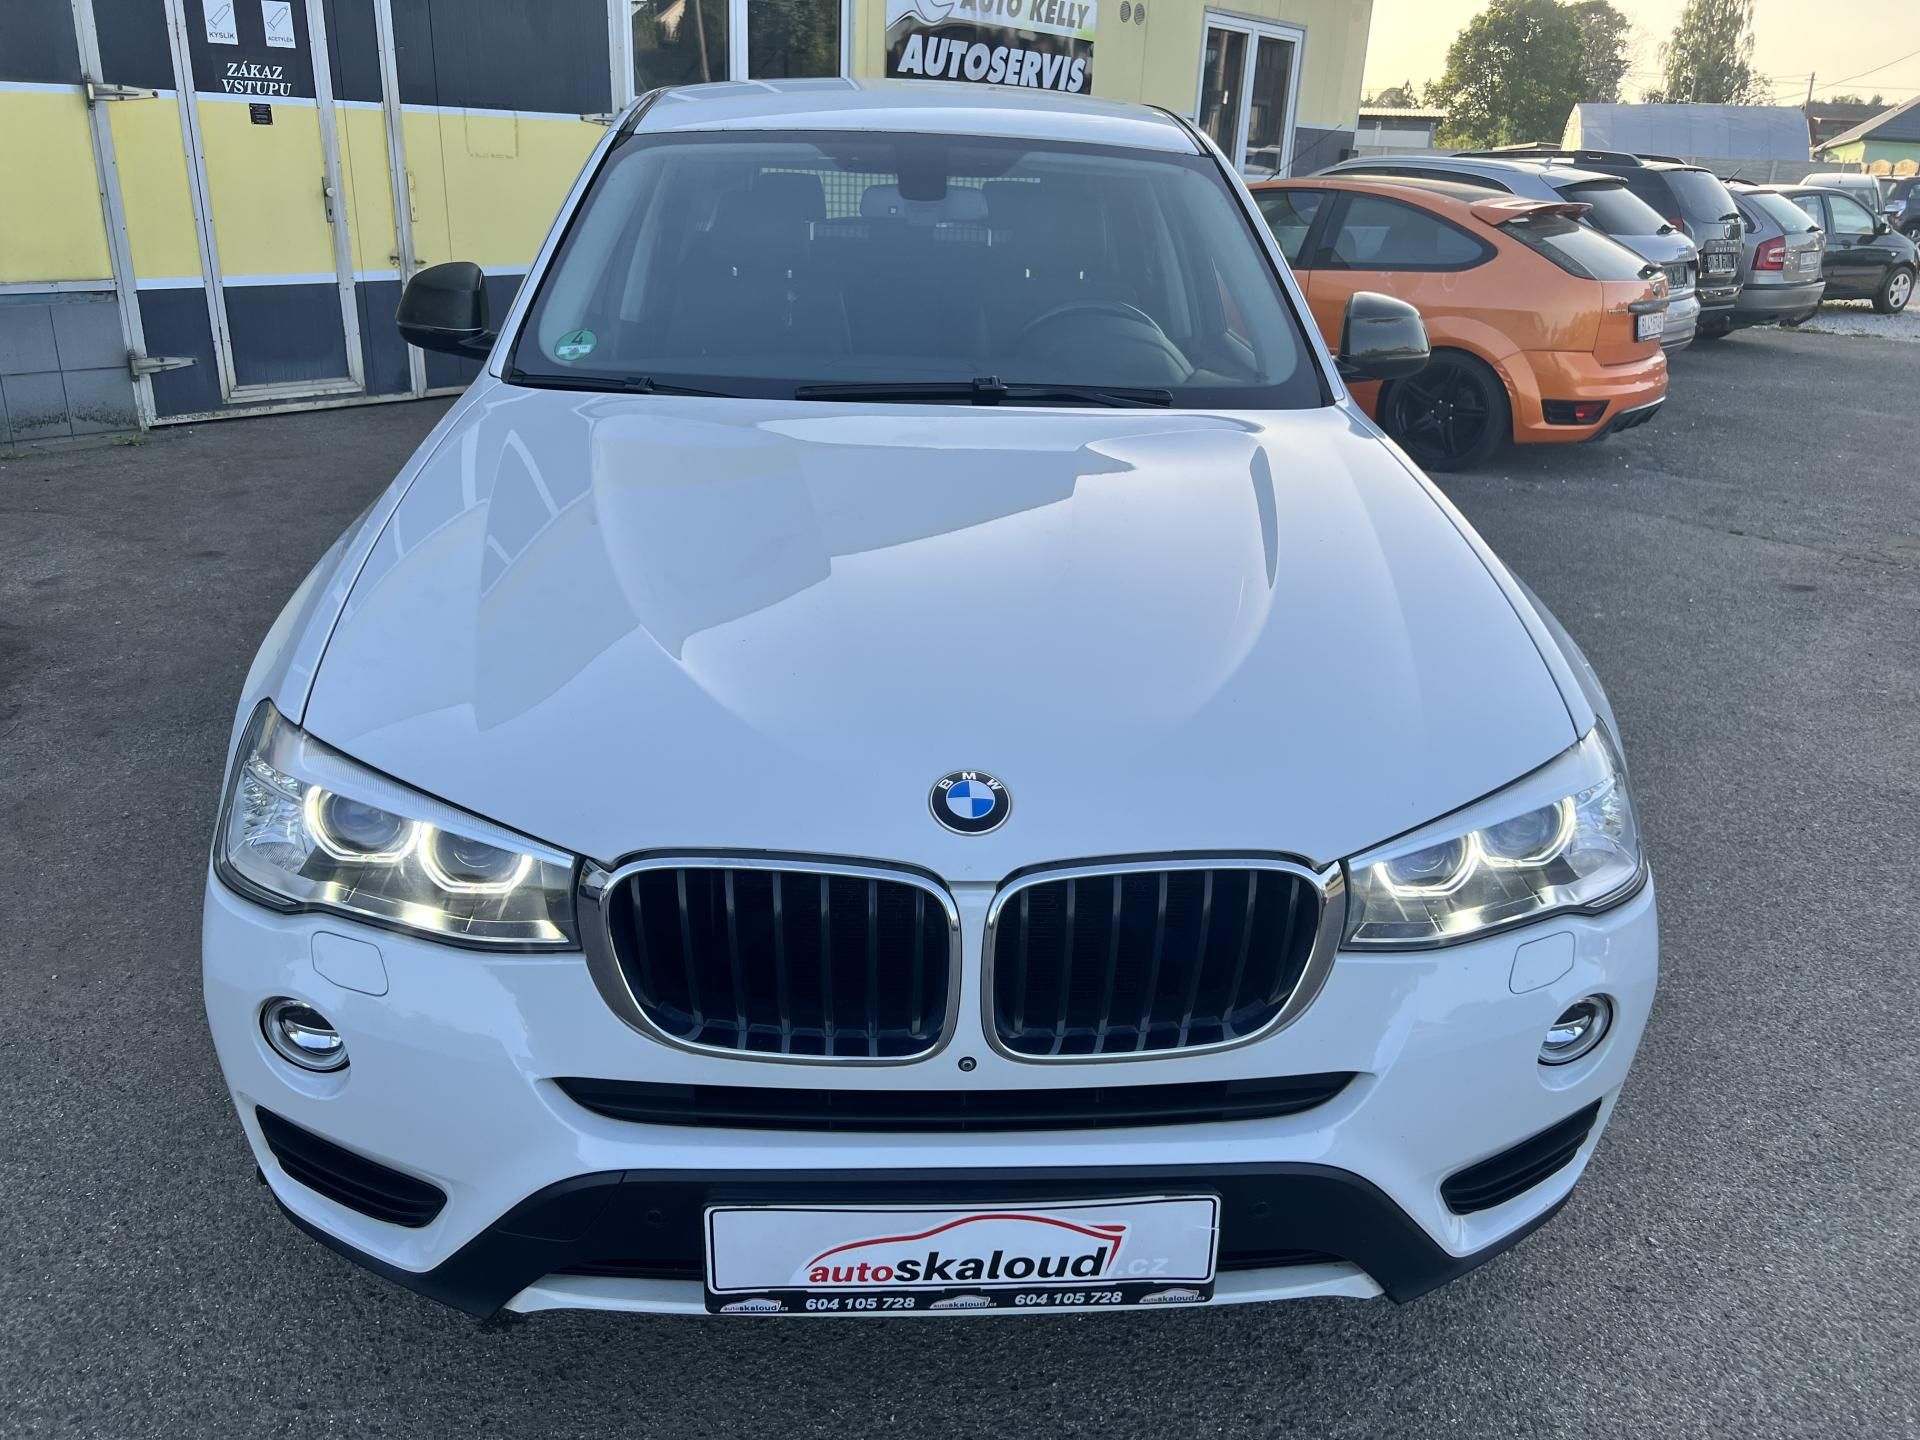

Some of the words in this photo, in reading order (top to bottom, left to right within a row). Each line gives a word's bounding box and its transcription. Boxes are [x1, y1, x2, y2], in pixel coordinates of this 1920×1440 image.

[1029, 0, 1090, 29] KELLY
[226, 60, 283, 80] ZÁKAZ
[897, 34, 1086, 94] AUTOSERVIS
[221, 79, 292, 96] VSTUPU
[571, 329, 584, 345] 4
[938, 772, 1002, 791] BMW
[805, 1298, 840, 1311] 604
[845, 1297, 878, 1310] 105
[881, 1296, 916, 1310] 728
[1014, 1293, 1048, 1305] 604
[1052, 1292, 1085, 1304] 105
[1088, 1291, 1123, 1304] 728
